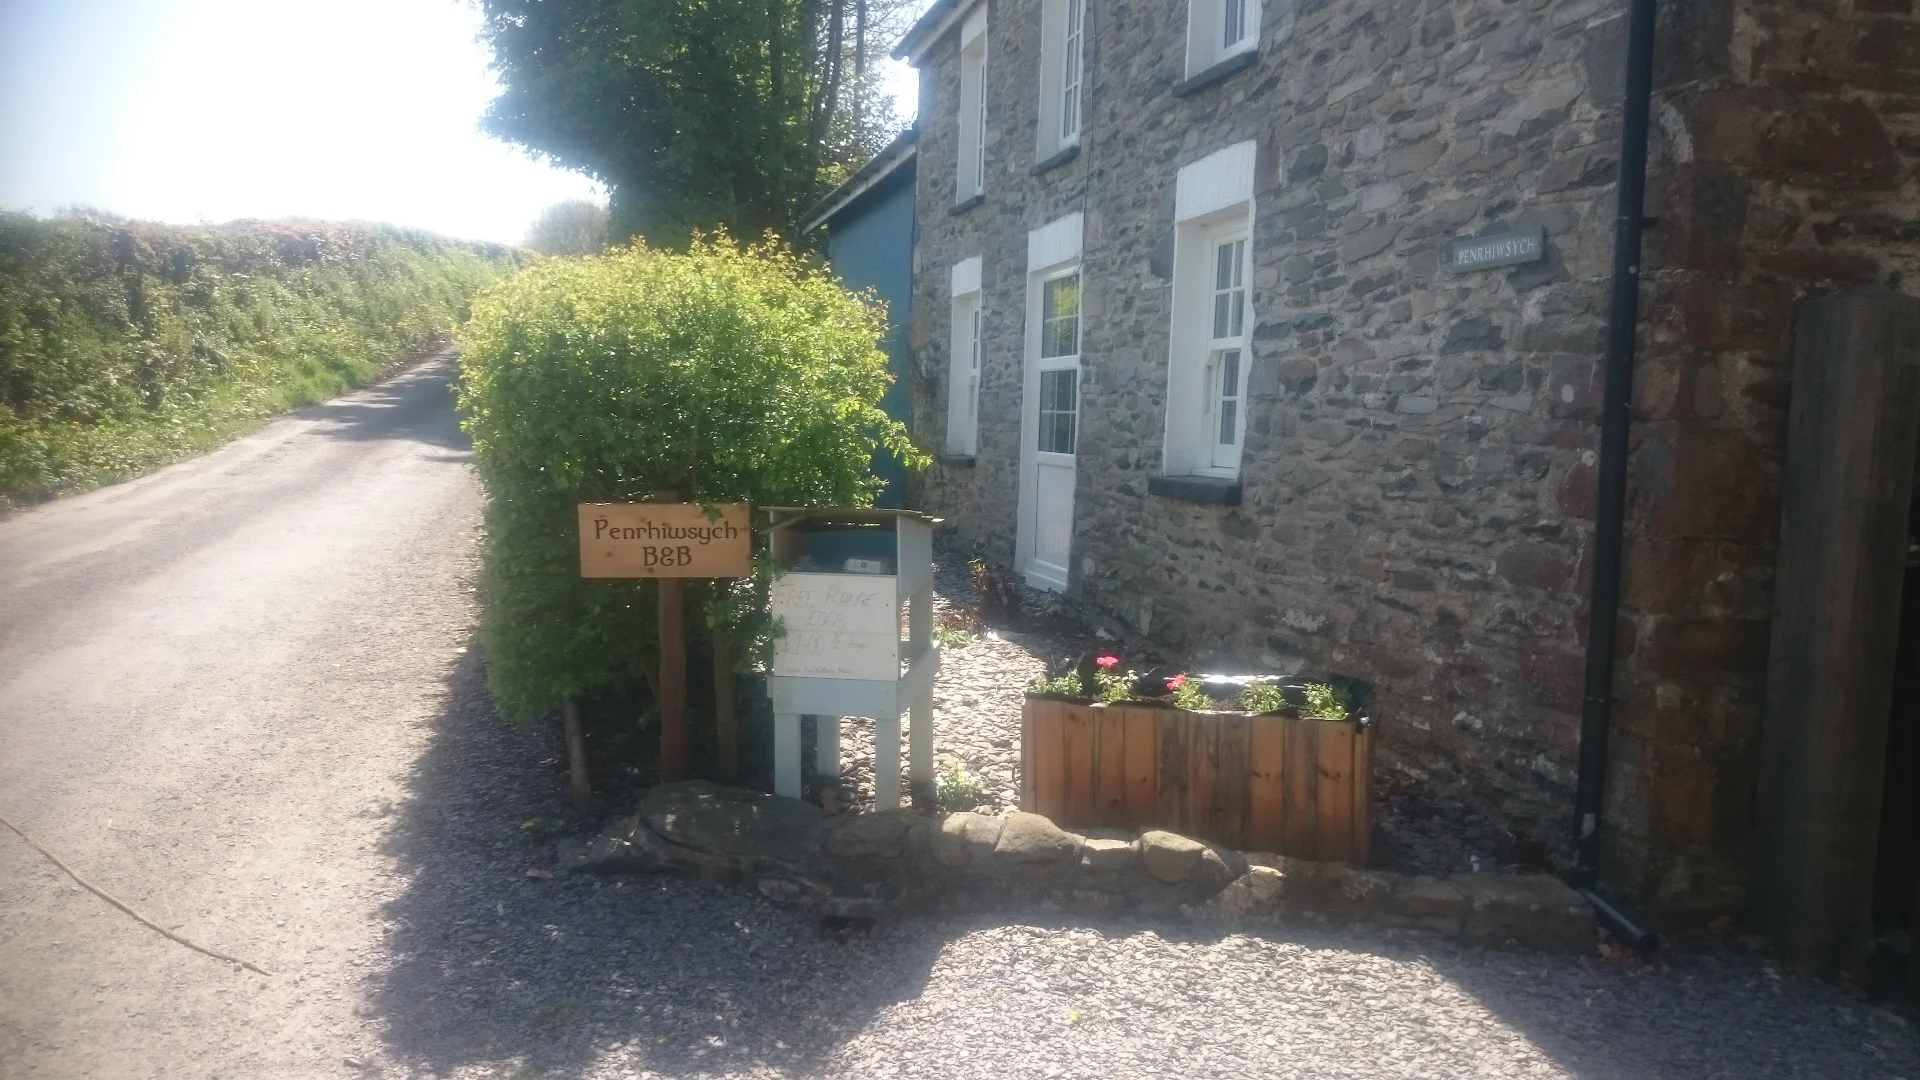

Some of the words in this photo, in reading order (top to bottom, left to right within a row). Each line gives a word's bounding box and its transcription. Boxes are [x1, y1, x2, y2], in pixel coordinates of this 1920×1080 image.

[1458, 238, 1535, 264] PENRHIWSYCH
[593, 518, 738, 545] Penrhiwsych
[641, 545, 692, 567] B&B
[773, 583, 817, 608] FREE
[824, 584, 878, 608] RANGE
[806, 610, 846, 629] EGGS
